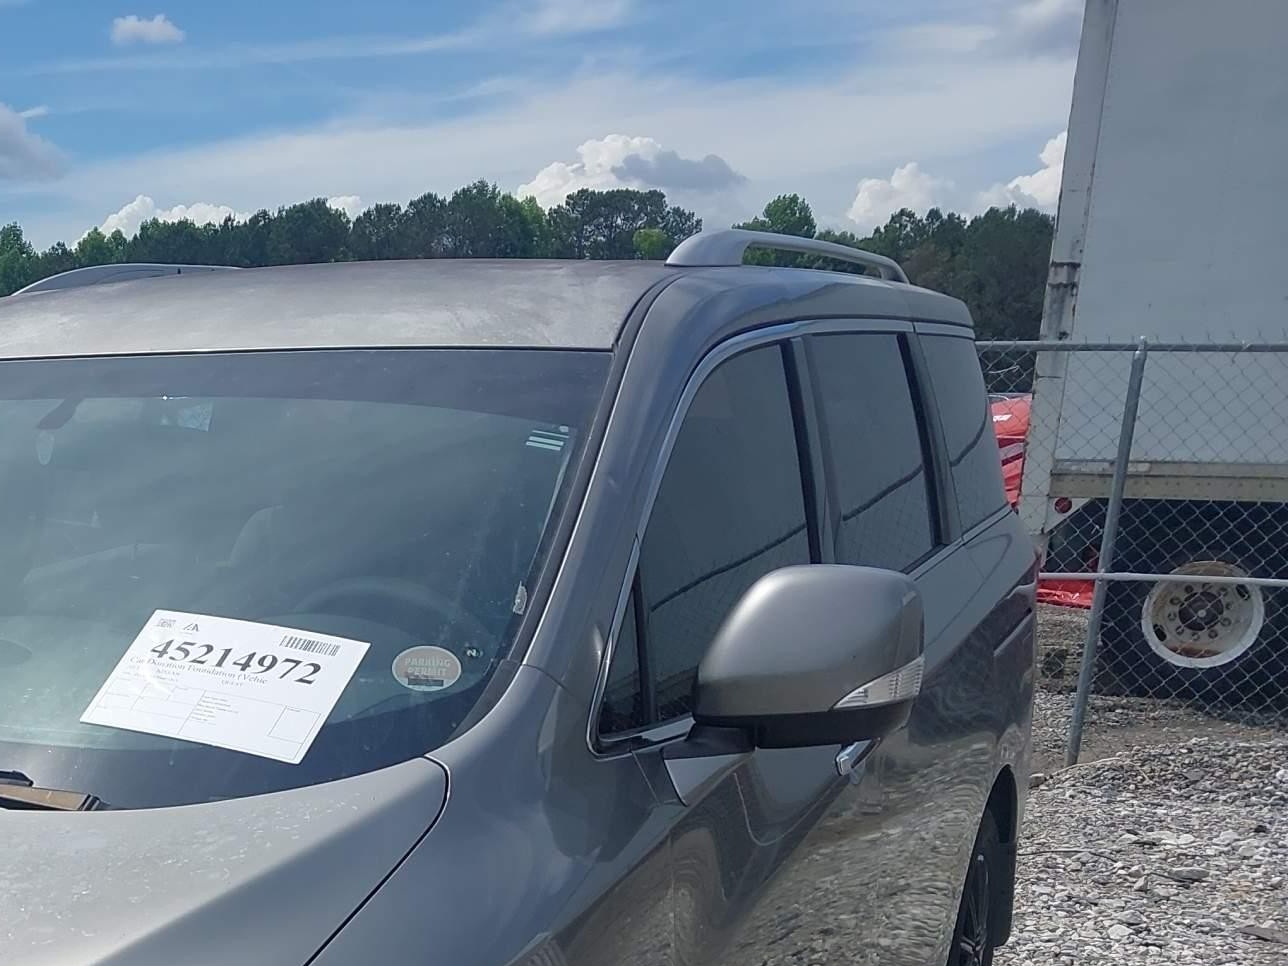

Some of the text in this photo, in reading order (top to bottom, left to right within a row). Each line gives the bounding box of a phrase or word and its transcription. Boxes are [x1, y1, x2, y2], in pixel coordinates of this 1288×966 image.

[147, 657, 186, 671] Donation
[187, 664, 237, 679] Foundation
[150, 639, 322, 685] 45214972
